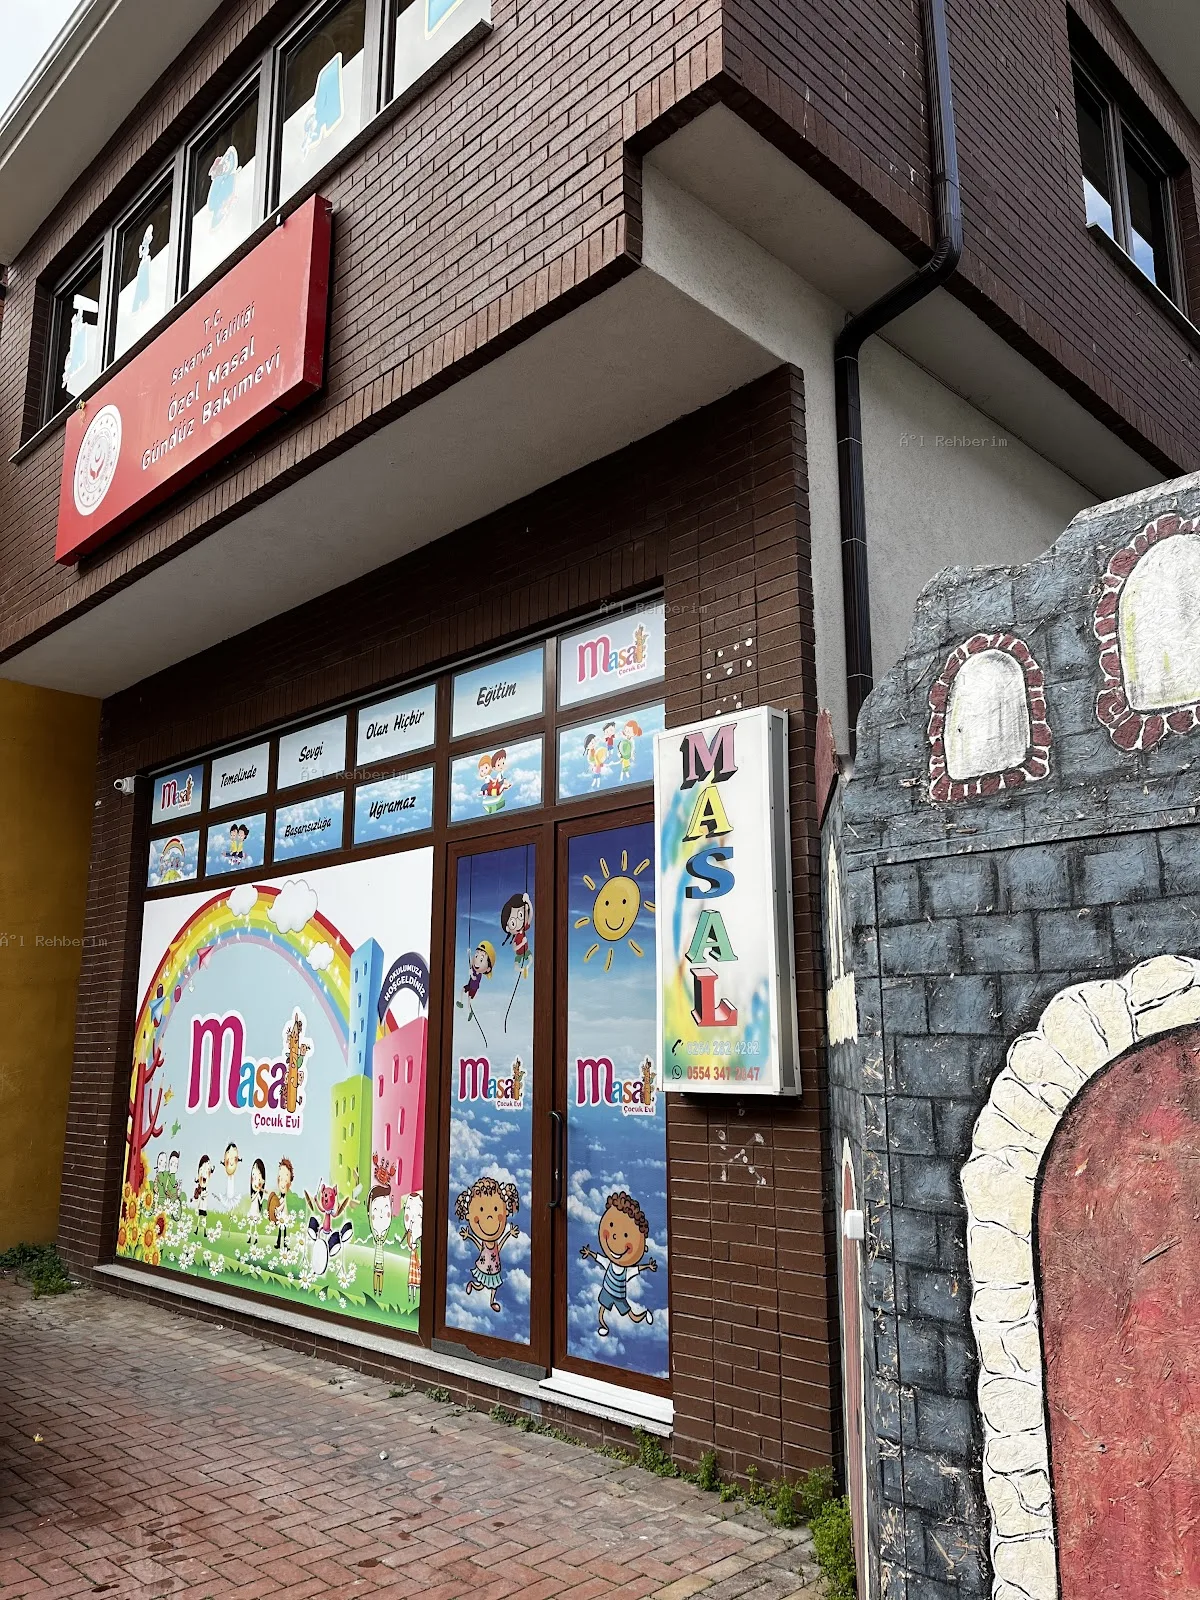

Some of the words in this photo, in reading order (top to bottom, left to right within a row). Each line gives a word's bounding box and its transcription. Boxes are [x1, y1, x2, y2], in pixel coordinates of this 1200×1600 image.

[204, 308, 223, 335] T.C.
[171, 341, 213, 385] Sakarya
[215, 300, 255, 347] Valiliği
[168, 380, 200, 422] Özel
[206, 334, 255, 391] Masal
[142, 418, 195, 470] Gündüz
[202, 346, 281, 425] Bakımevi
[477, 681, 517, 708] Eğitim
[366, 723, 389, 740] Olan
[393, 709, 425, 732] Hiçbir
[298, 741, 324, 763] Sevgi
[220, 764, 257, 788] Temelinde
[369, 796, 417, 819] Uğramaz
[680, 722, 739, 1028] MASAL
[388, 963, 423, 983] OKULUMUZA
[384, 975, 426, 1002] HOŞGELDİNİZ
[734, 1041, 760, 1056] 4282
[686, 1066, 711, 1080] 0554
[713, 1066, 732, 1080] 347
[254, 1112, 283, 1129] Çocuk
[285, 1115, 301, 1129] Evi
[623, 1105, 643, 1114] Çocuk
[644, 1105, 655, 1113] Evi
